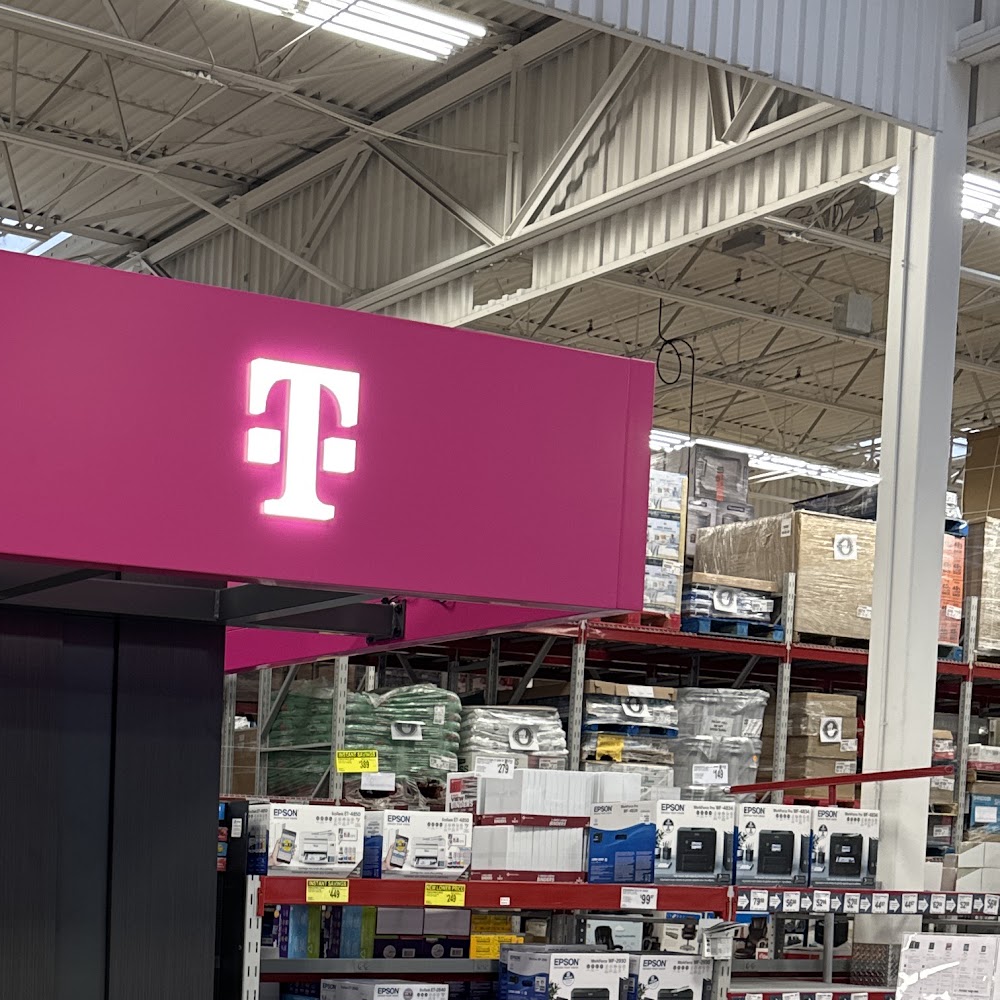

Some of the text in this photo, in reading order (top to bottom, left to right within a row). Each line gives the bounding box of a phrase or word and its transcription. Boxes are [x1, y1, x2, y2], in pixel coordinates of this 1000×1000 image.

[245, 357, 361, 521] T
[661, 803, 685, 811] EPSON
[743, 806, 765, 814] EPSON
[273, 808, 298, 817] EPSON
[817, 810, 838, 818] EPSON
[387, 815, 411, 823] EPSON
[554, 958, 579, 966] EPSON
[643, 959, 667, 967] EPSON
[377, 987, 399, 995] EPSON
